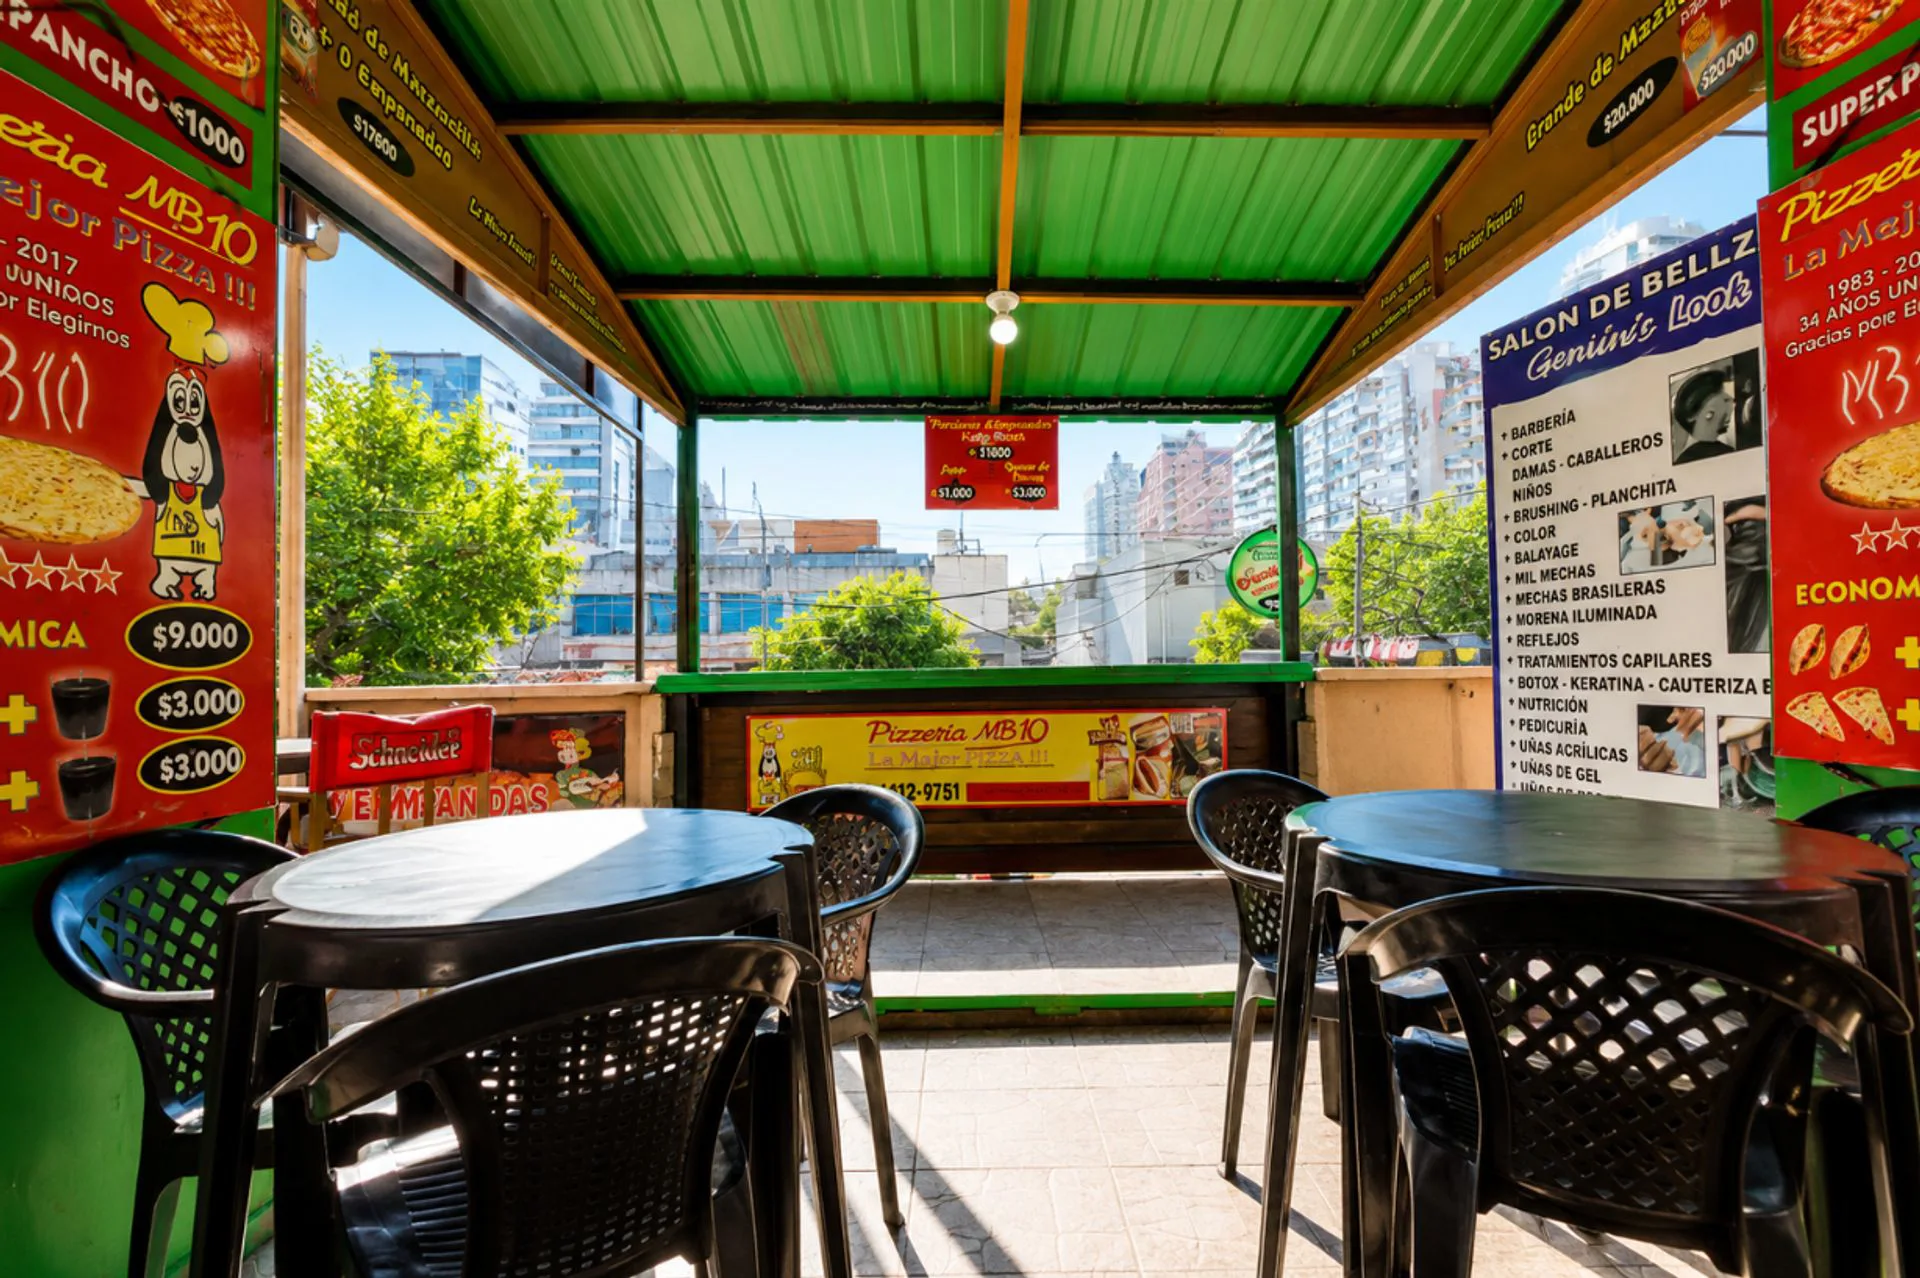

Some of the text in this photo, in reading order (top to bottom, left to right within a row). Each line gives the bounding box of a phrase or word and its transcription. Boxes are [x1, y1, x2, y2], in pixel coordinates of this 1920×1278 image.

[1525, 82, 1585, 150] Grande
[1590, 55, 1614, 87] de
[1603, 78, 1655, 134] $20.000
[124, 174, 258, 266] MB10
[16, 236, 79, 275] 2017
[1784, 246, 1827, 281] La
[1828, 269, 1875, 300] 1983
[1667, 270, 1753, 332] Look
[1799, 312, 1820, 333] 34
[1826, 290, 1881, 324] AÑOS
[27, 296, 131, 349] Elegirnos
[1488, 303, 1580, 361] SALON
[1588, 281, 1632, 320] DE
[1785, 325, 1852, 358] Gracias
[1510, 408, 1577, 441] BARBERÍA
[1511, 438, 1554, 462] CORTE
[1511, 461, 1557, 482] DAMAS
[1567, 431, 1664, 468] CABALLEROS
[1512, 482, 1553, 503] NIÑOS
[1513, 498, 1580, 524] BRUSHING
[1591, 478, 1677, 509] PLANCHITA
[1513, 524, 1557, 544] COLOR
[1514, 542, 1579, 565] BALAYAGE
[1515, 563, 1596, 585] MIL MECHAS
[1515, 578, 1666, 606] MECHAS BRASILERAS
[1516, 604, 1658, 627] MORENA ILUMINADA
[0, 620, 88, 649] MICA
[153, 621, 239, 653] $9.000
[1516, 631, 1580, 648] REFLEJOS
[1517, 652, 1713, 669] TRATAMIENTOS CAPILARES
[1517, 675, 1559, 691] BOTOX
[1570, 676, 1645, 693] KERATINA
[1659, 677, 1758, 695] CAUTERIZA
[158, 686, 241, 720] $3.000
[1518, 695, 1588, 713] NUTRICIÓN
[973, 717, 1050, 744] MB10
[1519, 716, 1588, 736] PEDICURÍA
[159, 746, 241, 783] $3.000
[1519, 736, 1629, 763] UÑAS ACRÍLICAS
[1520, 758, 1602, 784] UÑAS DE GEL
